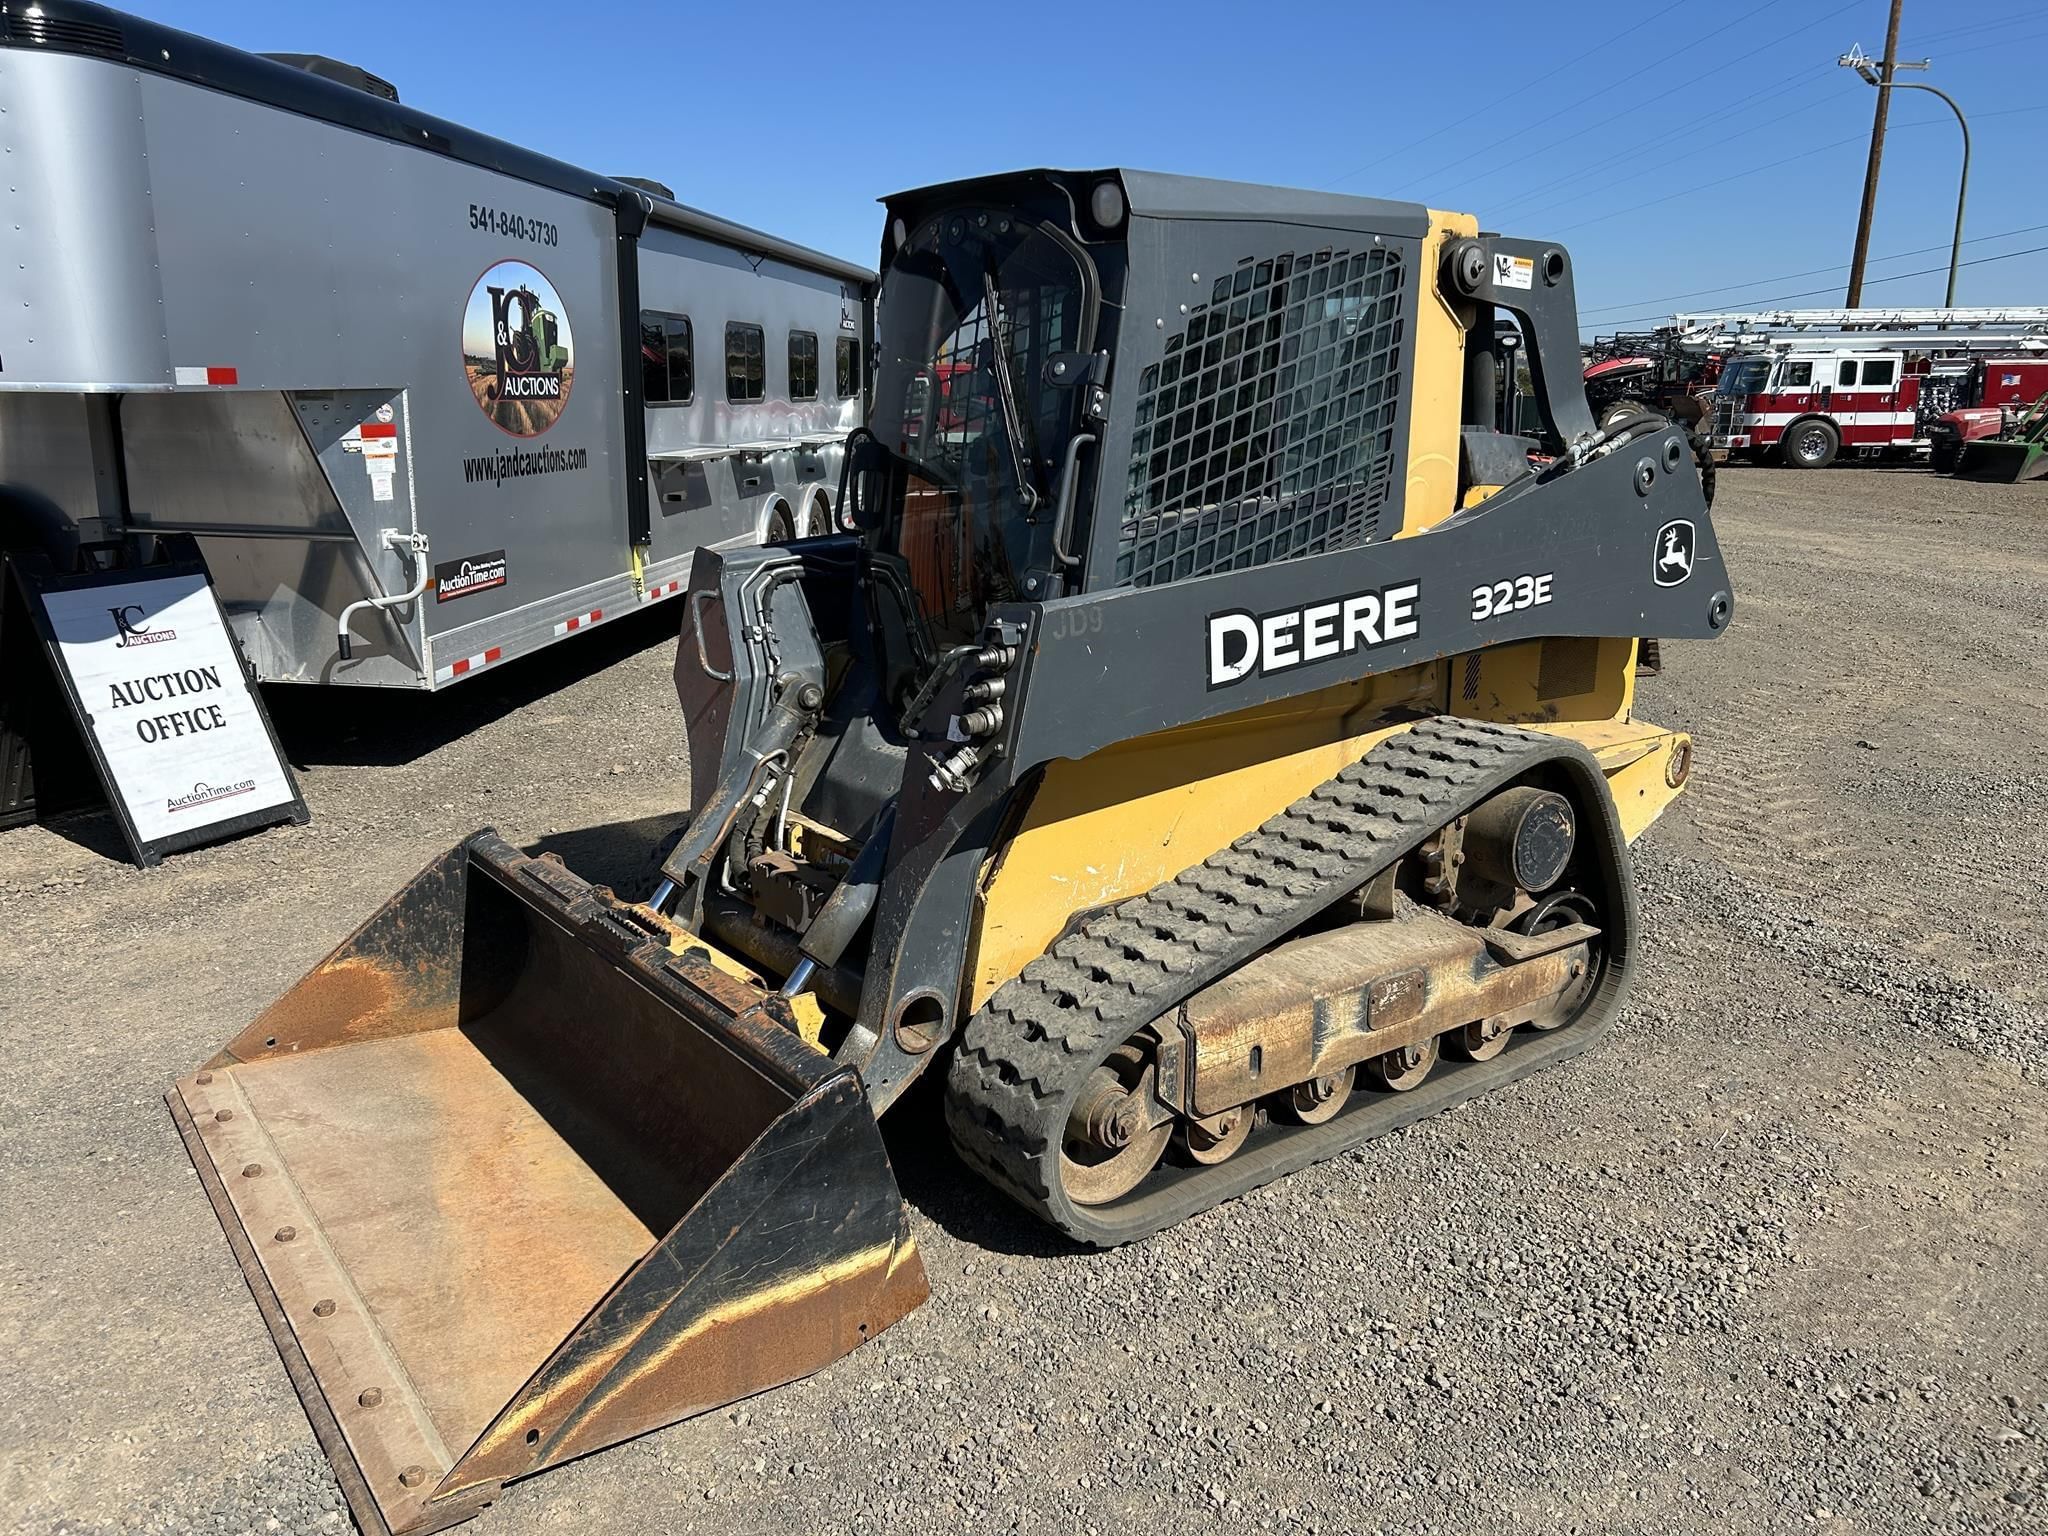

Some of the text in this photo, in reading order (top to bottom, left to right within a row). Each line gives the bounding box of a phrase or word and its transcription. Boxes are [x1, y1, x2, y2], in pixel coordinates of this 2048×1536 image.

[470, 203, 558, 248] 541-840-3730
[504, 377, 559, 397] AUCTIONS
[463, 443, 588, 489] www.jandcauctions.com
[439, 566, 505, 593] AuctionTime.com
[129, 630, 176, 647] AUCTIONS
[1209, 573, 1554, 686] DEERE 323E
[109, 665, 222, 709] AUCTION
[136, 704, 227, 744] OFFICE
[167, 779, 256, 808] AuctionTime.com
